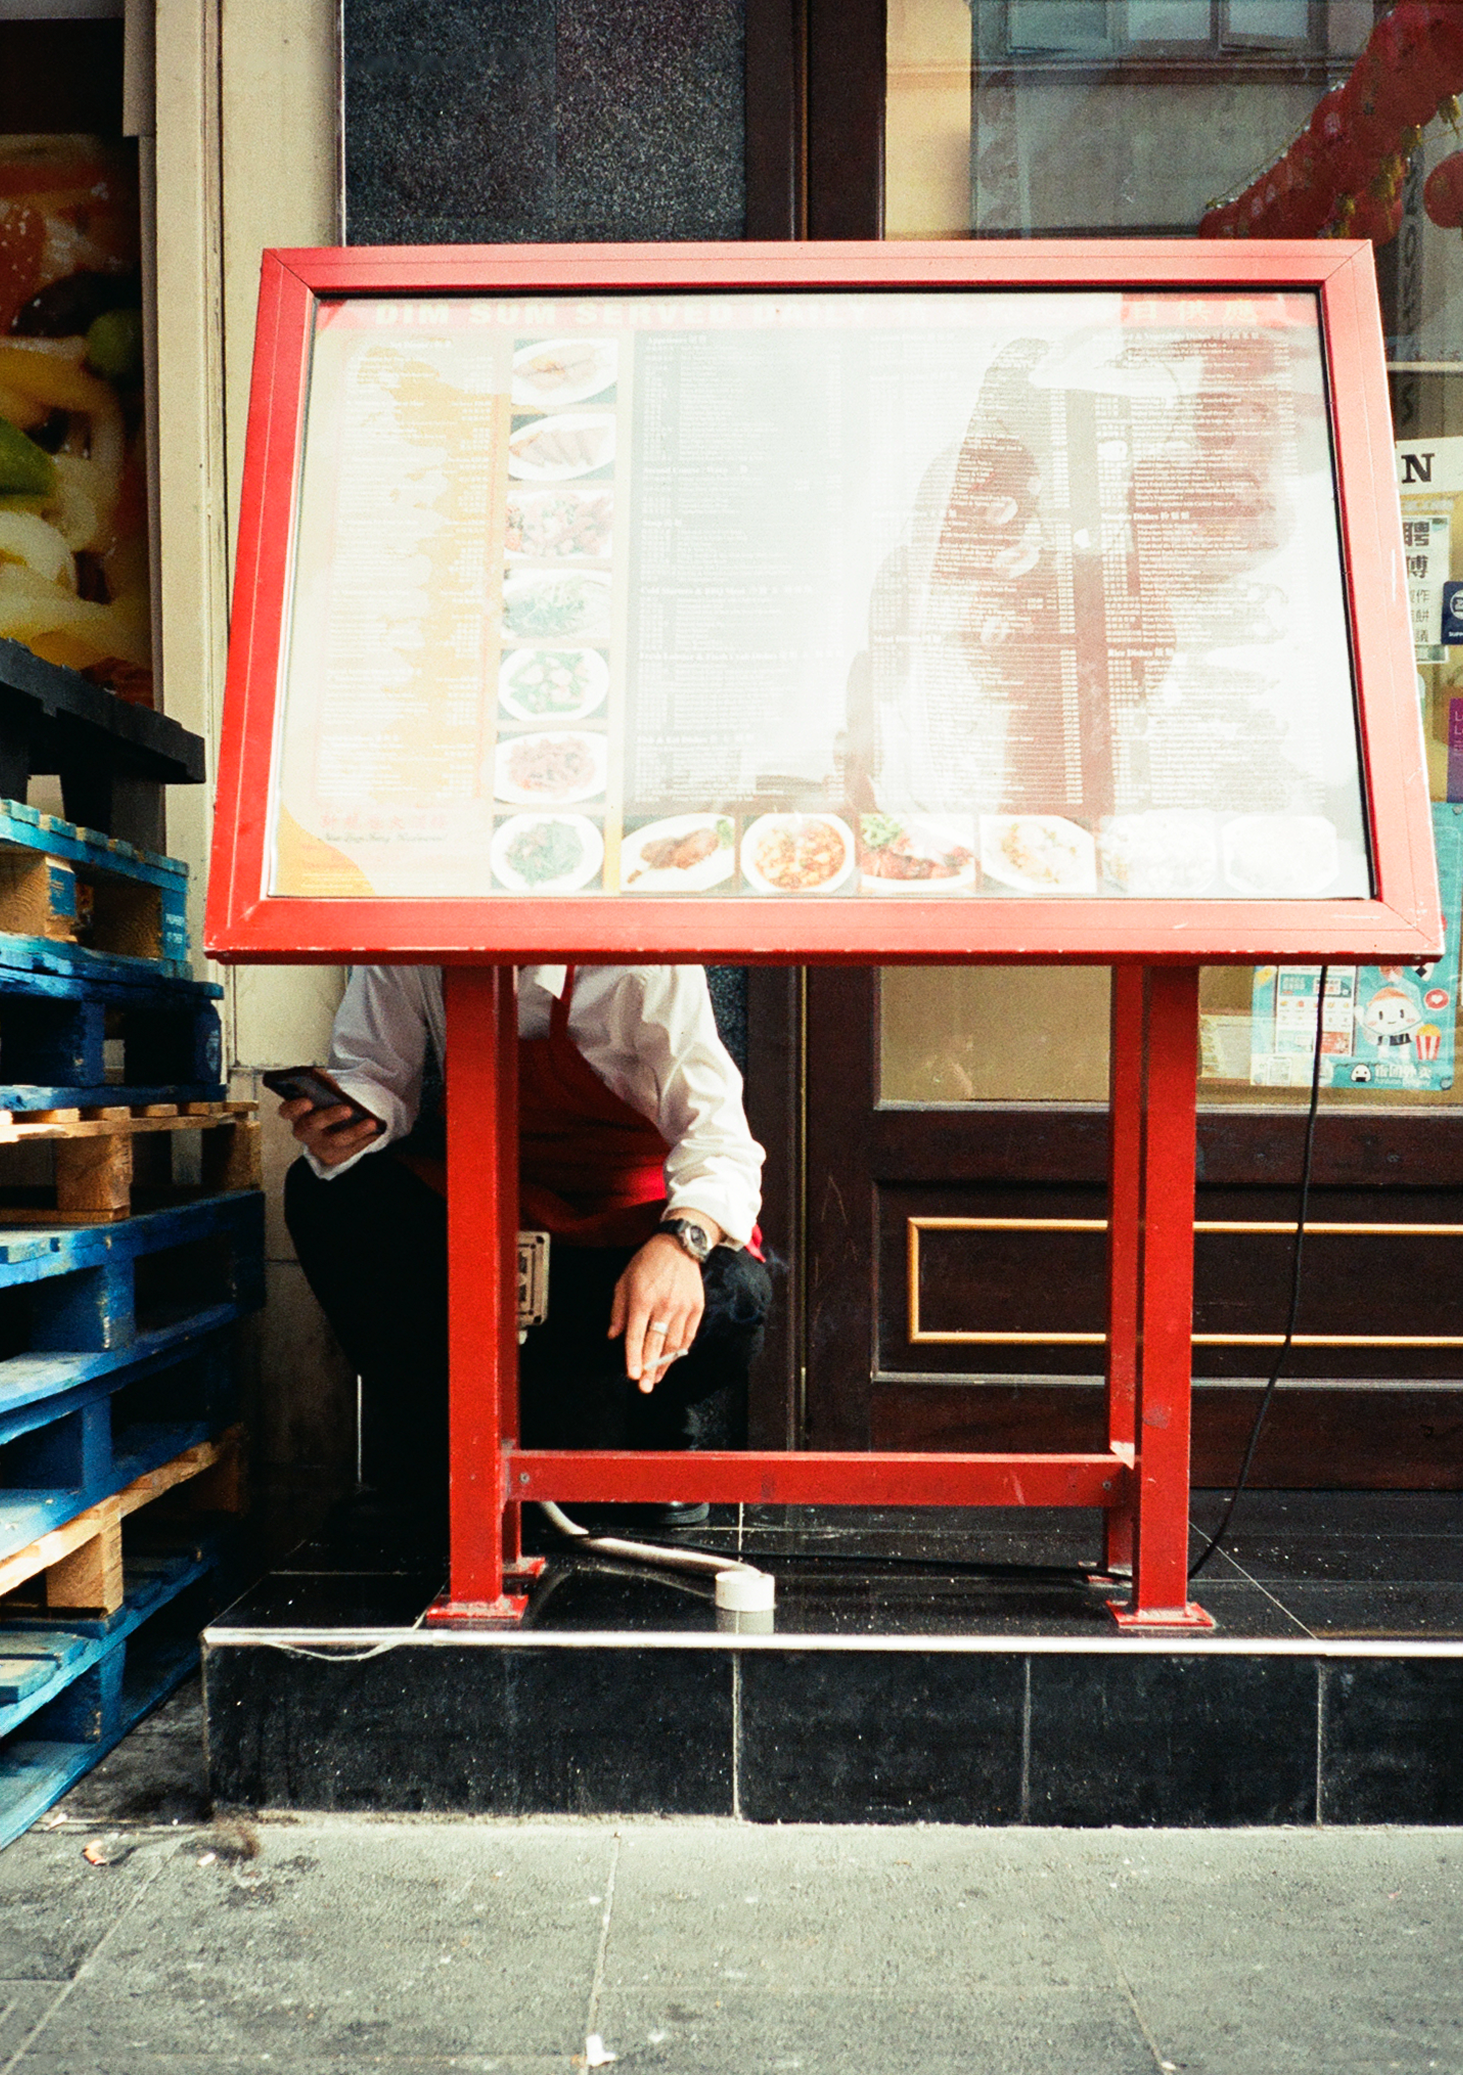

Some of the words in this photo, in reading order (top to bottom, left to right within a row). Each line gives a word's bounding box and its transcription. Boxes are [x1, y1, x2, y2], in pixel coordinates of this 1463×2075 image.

[374, 304, 450, 325] DIM
[469, 303, 557, 325] SUM
[574, 302, 733, 325] SERVED
[752, 302, 869, 324] DAILY
[1401, 453, 1435, 484] N
